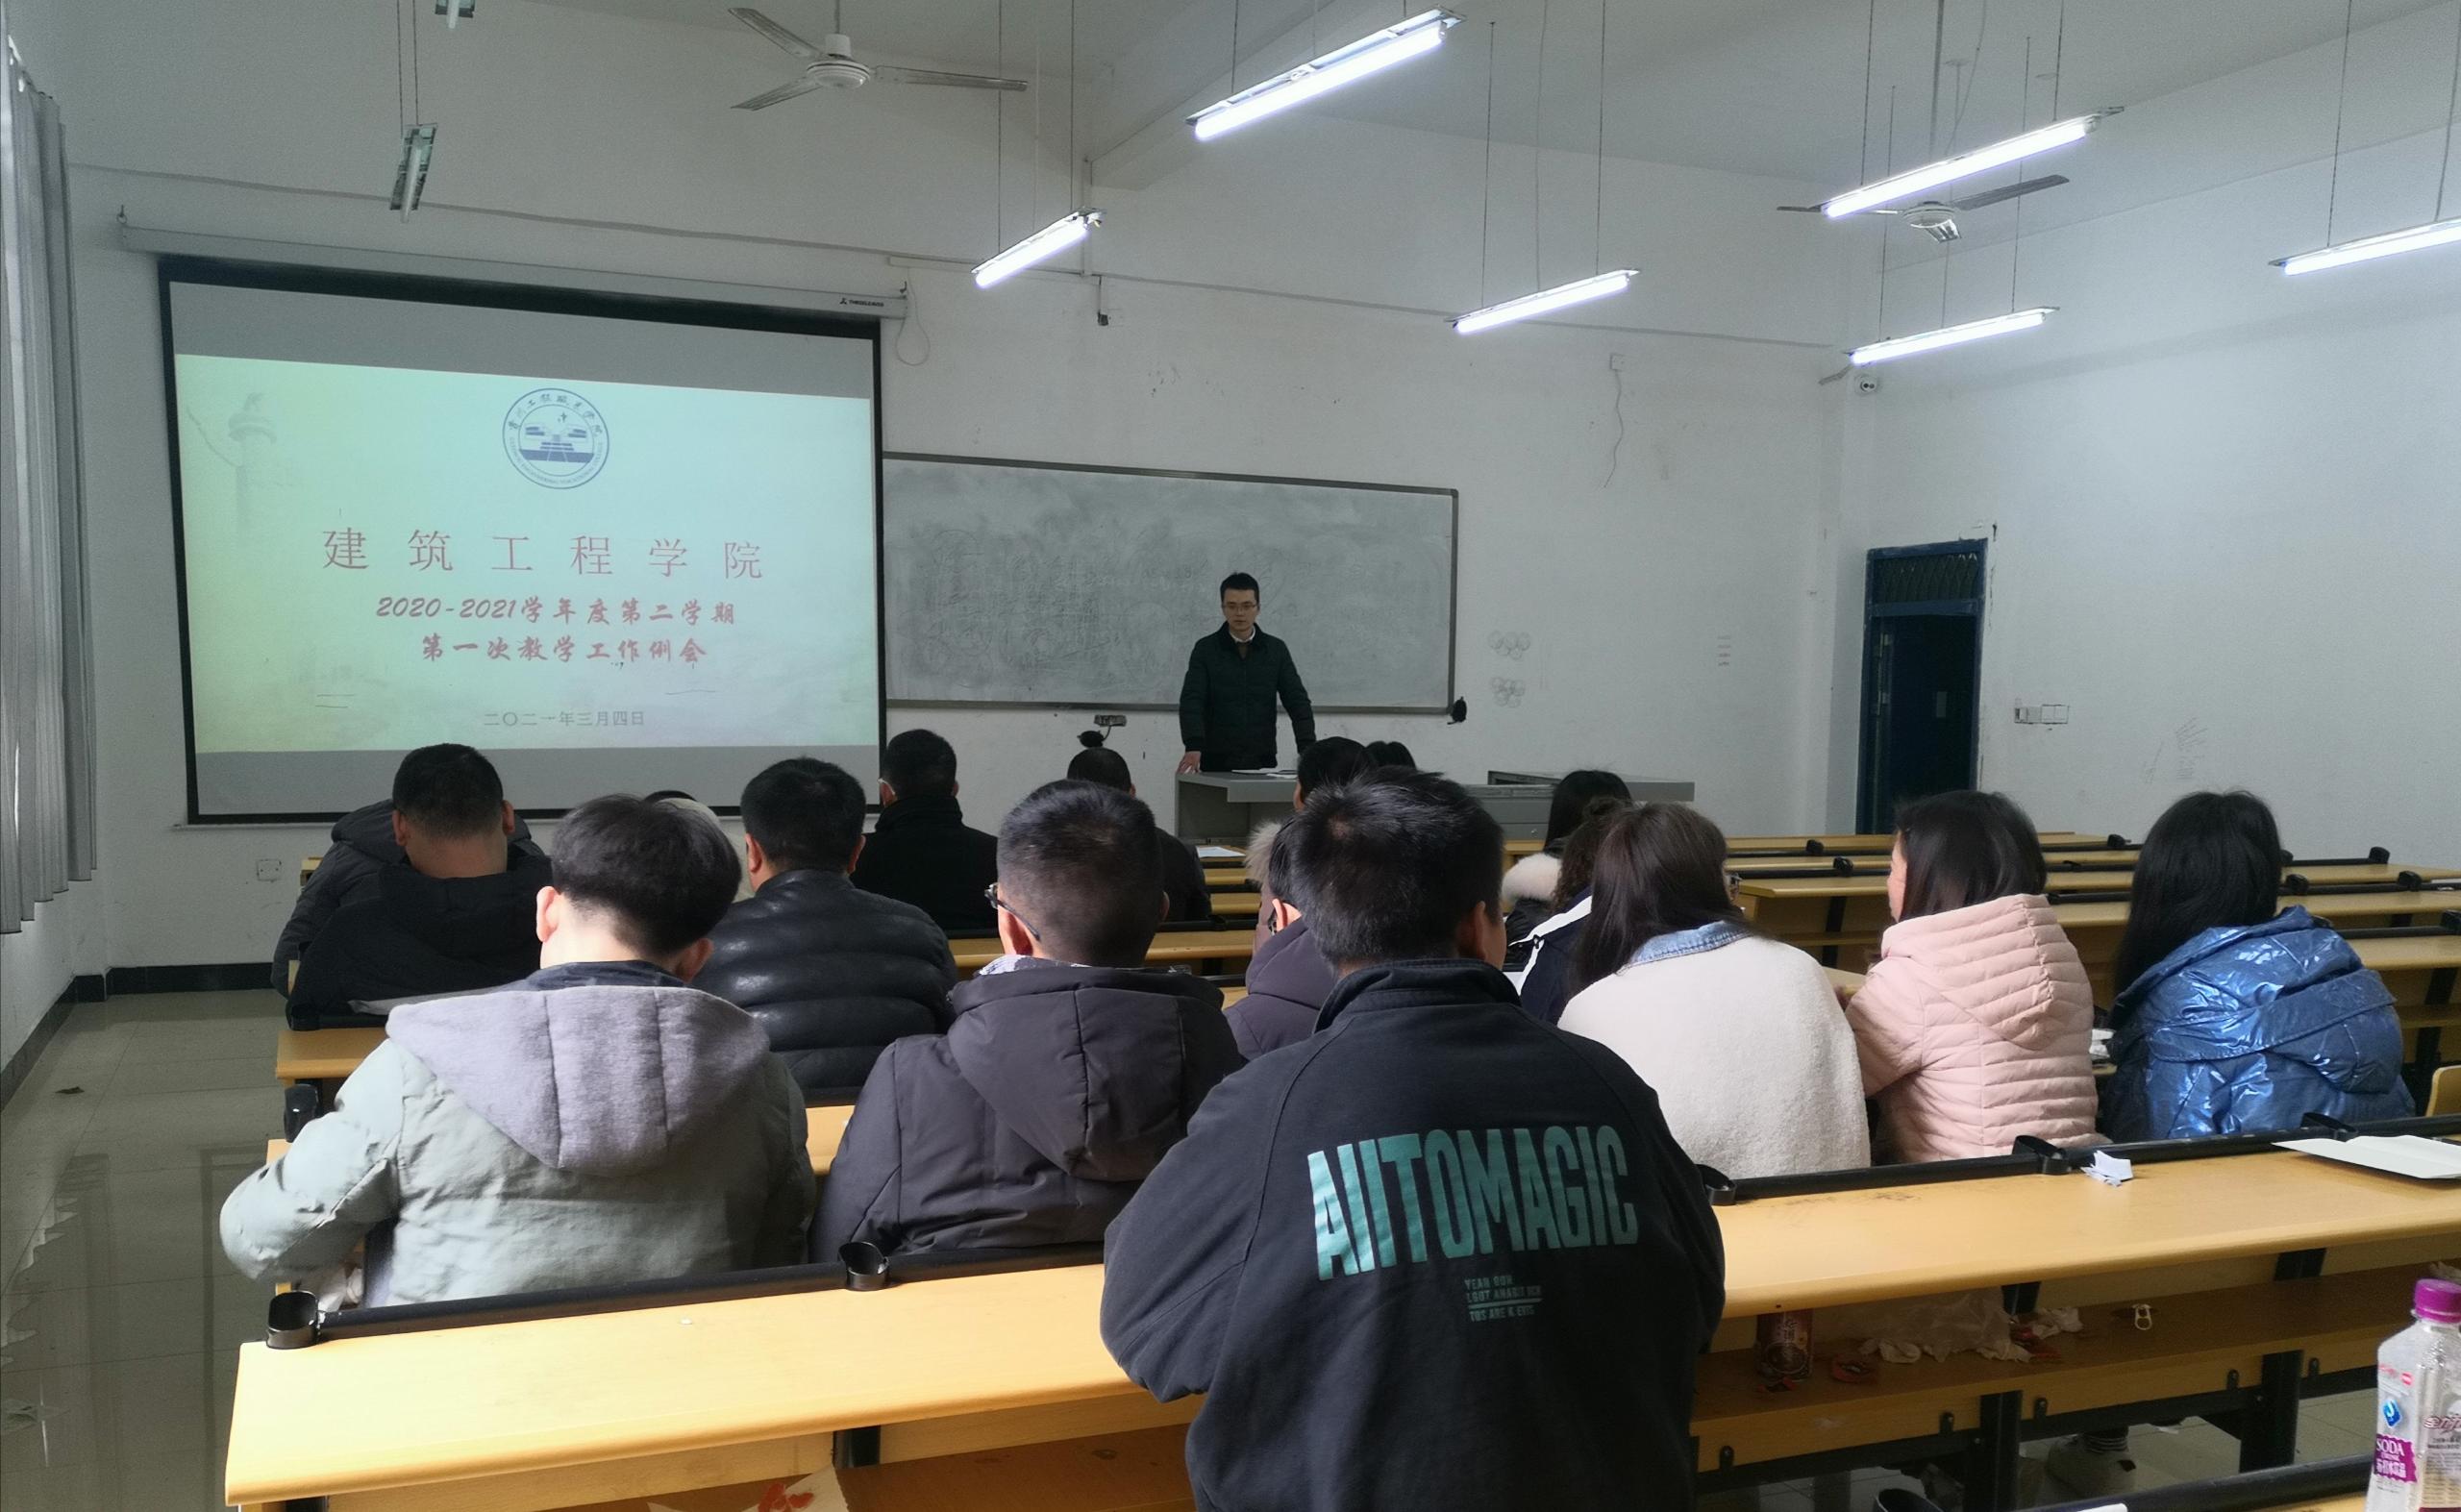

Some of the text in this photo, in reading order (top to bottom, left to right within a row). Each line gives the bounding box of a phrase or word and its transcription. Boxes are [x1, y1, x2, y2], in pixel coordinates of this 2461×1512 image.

[322, 528, 763, 580] 建筑工程学院
[376, 597, 734, 625] 2020-2021学年度第二学期
[422, 632, 707, 663] 第一次教学工作例会
[2376, 1438, 2405, 1457] SODA
